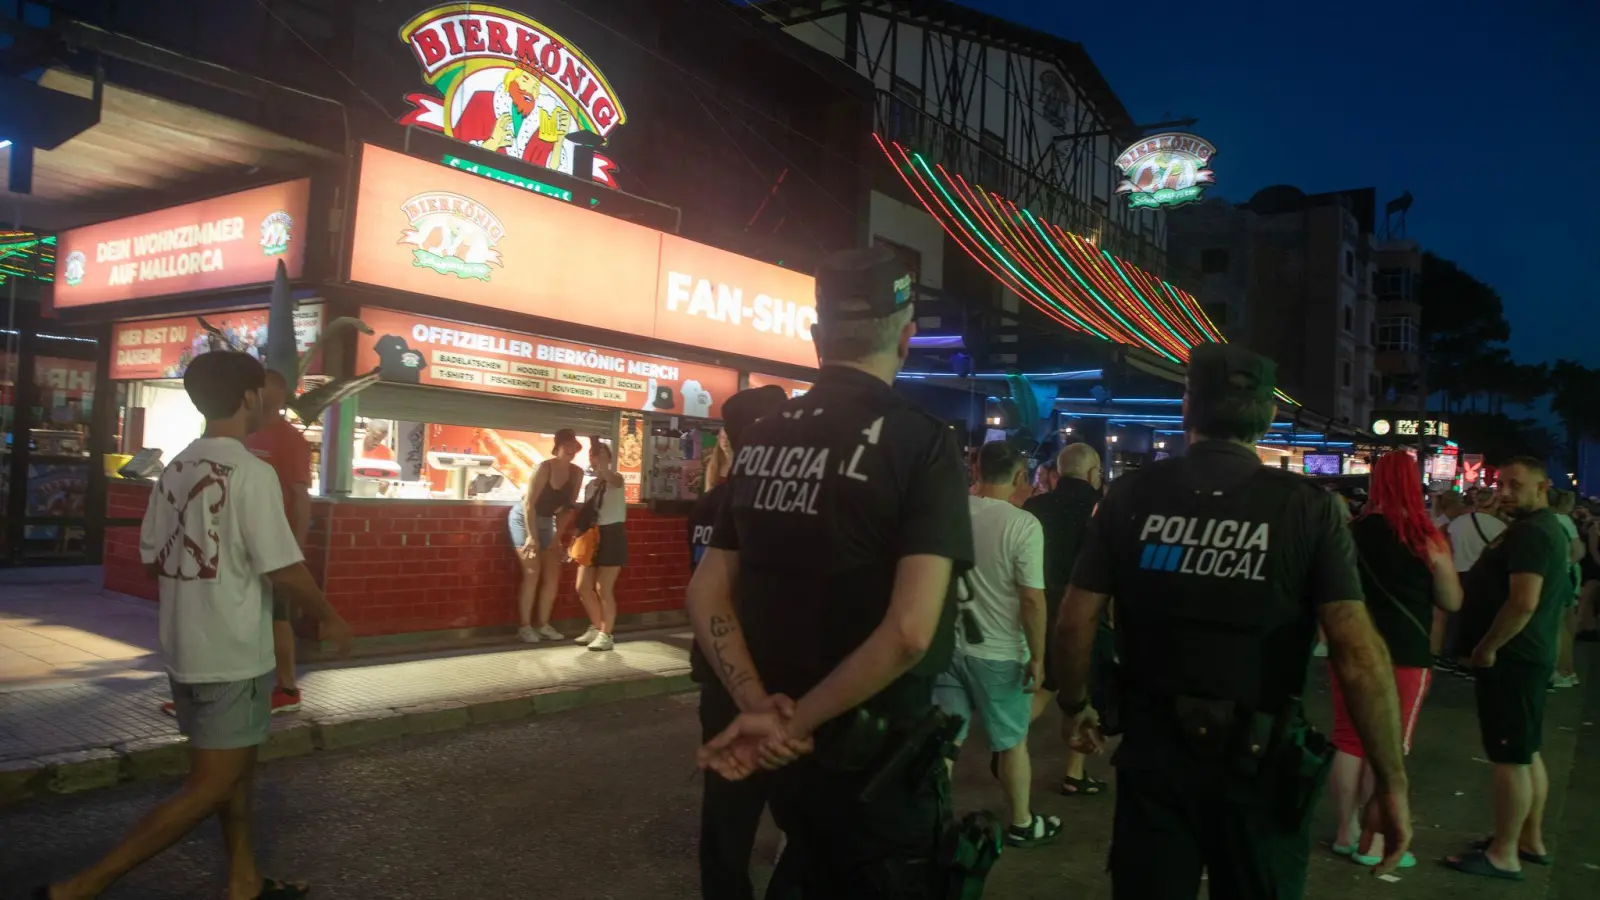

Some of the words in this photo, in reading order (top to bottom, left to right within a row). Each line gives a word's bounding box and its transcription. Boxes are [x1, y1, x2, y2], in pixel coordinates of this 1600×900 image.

[415, 19, 616, 127] BIERKÖNIG
[1119, 136, 1210, 167] BIERKÖNIG
[405, 197, 502, 239] BIERKÖNIG
[96, 238, 130, 263] DEIN
[132, 217, 245, 257] WOHNZIMMER
[108, 261, 138, 286] AUF
[139, 248, 224, 281] MALLORCA
[117, 328, 142, 347] HIER
[144, 326, 168, 345] BIST
[169, 325, 188, 343] DU
[411, 323, 533, 359] OFFIZIELLER
[536, 344, 625, 374] BIERKÖNIG
[627, 359, 680, 381] MERCH
[439, 354, 502, 370] BADELATSCHEN
[516, 365, 550, 378] HOODIES
[617, 379, 643, 391] SOCKEN
[439, 369, 475, 382] T-SHIRTS
[732, 445, 830, 481] POLICIA
[753, 479, 821, 516] LOCAL
[1139, 514, 1270, 551] POLICIA
[1179, 546, 1268, 581] LOCAL
